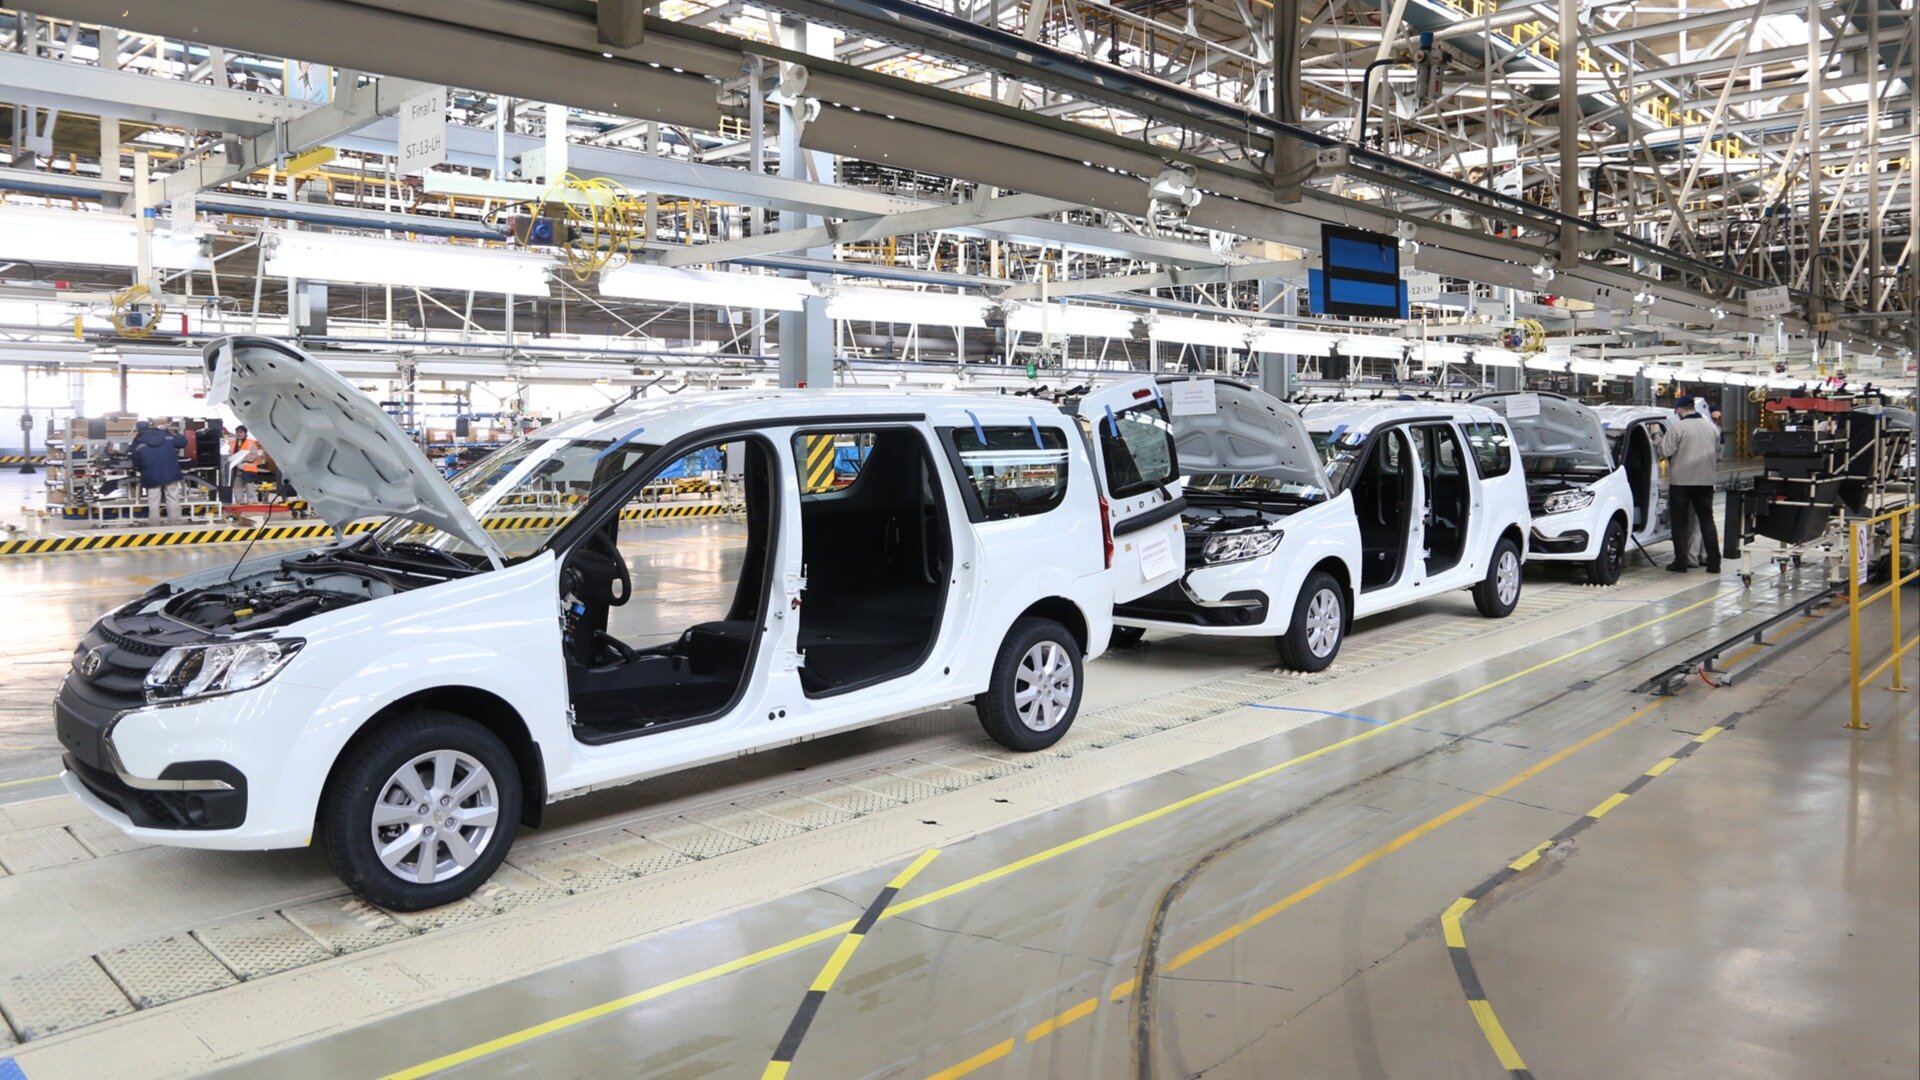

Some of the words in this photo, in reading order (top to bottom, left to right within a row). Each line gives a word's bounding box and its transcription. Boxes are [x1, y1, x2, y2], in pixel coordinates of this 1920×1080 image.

[412, 100, 430, 119] Final
[431, 97, 437, 113] 2
[406, 135, 440, 159] ST-13-LH
[1409, 286, 1433, 294] -12-LH
[1112, 496, 1156, 517] LADA
